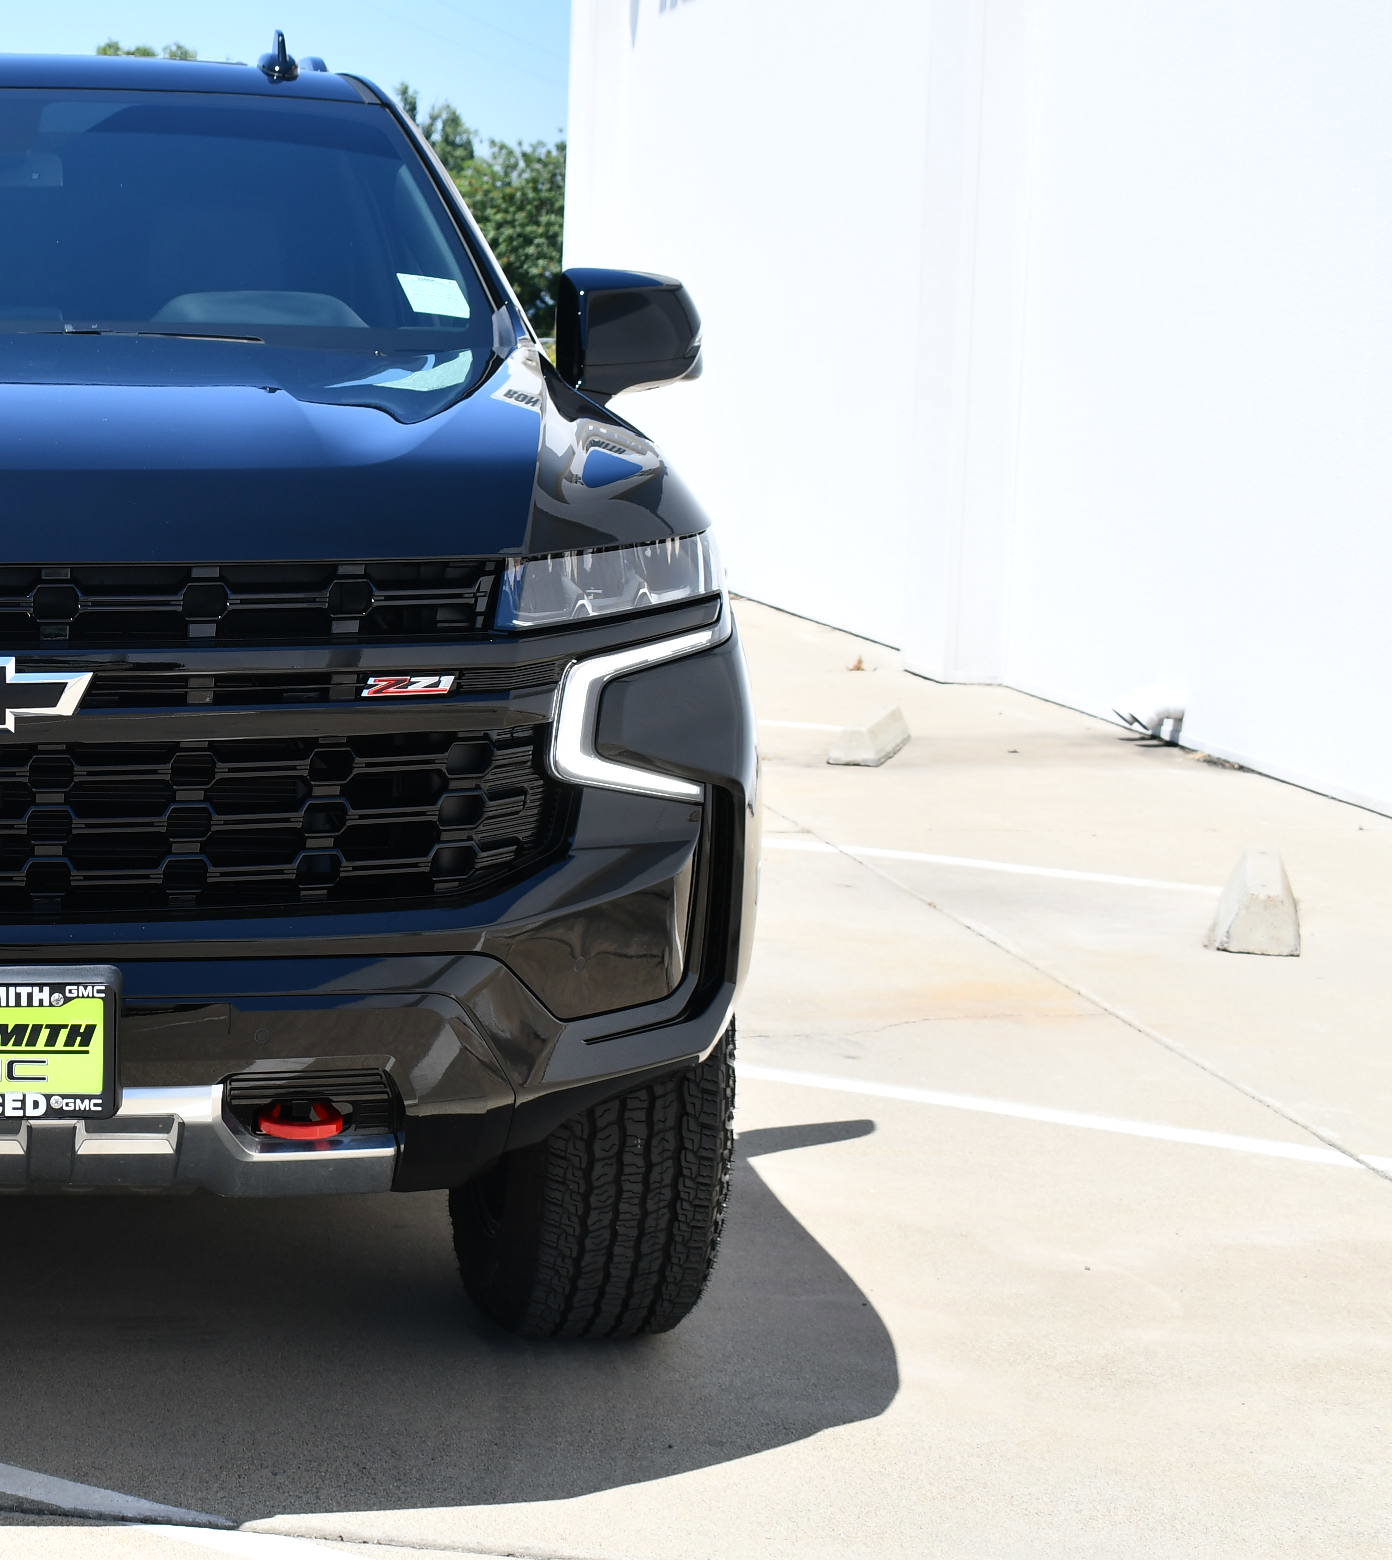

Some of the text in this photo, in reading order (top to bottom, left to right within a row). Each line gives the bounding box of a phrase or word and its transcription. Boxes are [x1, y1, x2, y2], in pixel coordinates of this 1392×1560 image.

[361, 675, 455, 697] Z71
[65, 985, 106, 998] GMC
[62, 1099, 103, 1111] GMC
